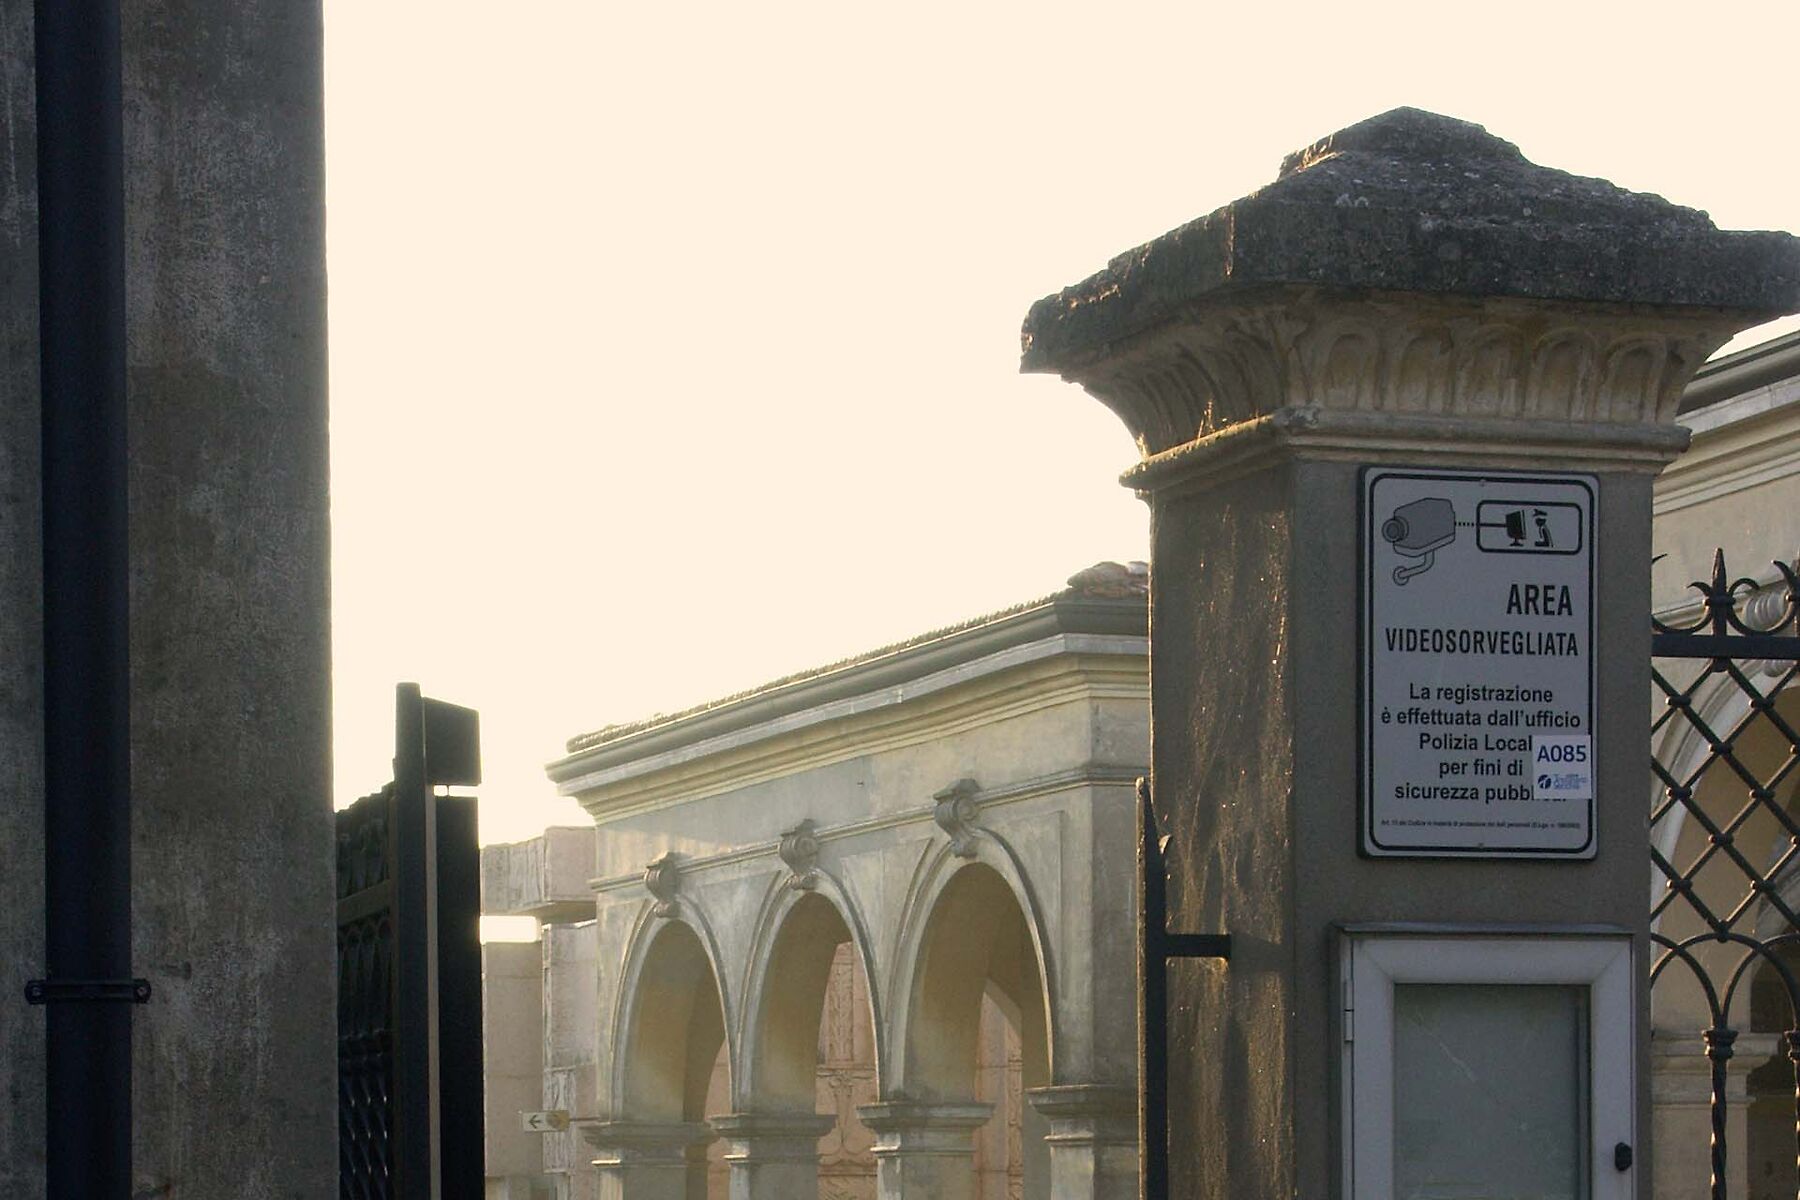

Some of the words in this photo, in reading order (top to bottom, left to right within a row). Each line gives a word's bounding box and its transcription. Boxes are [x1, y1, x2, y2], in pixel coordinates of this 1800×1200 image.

[1506, 584, 1573, 616] AREA
[1385, 628, 1579, 657] VIDEOSORVEGLIATA
[1409, 683, 1431, 701] La
[1436, 684, 1553, 705] registrazione
[1381, 706, 1391, 724] è
[1397, 707, 1481, 726] effettuata
[1419, 733, 1478, 750] Polizia
[1485, 734, 1533, 752] Local
[1537, 744, 1587, 763] A085
[1439, 762, 1468, 779] per
[1474, 759, 1500, 776] fini
[1507, 759, 1523, 776] di
[1395, 782, 1479, 800] sicurezza
